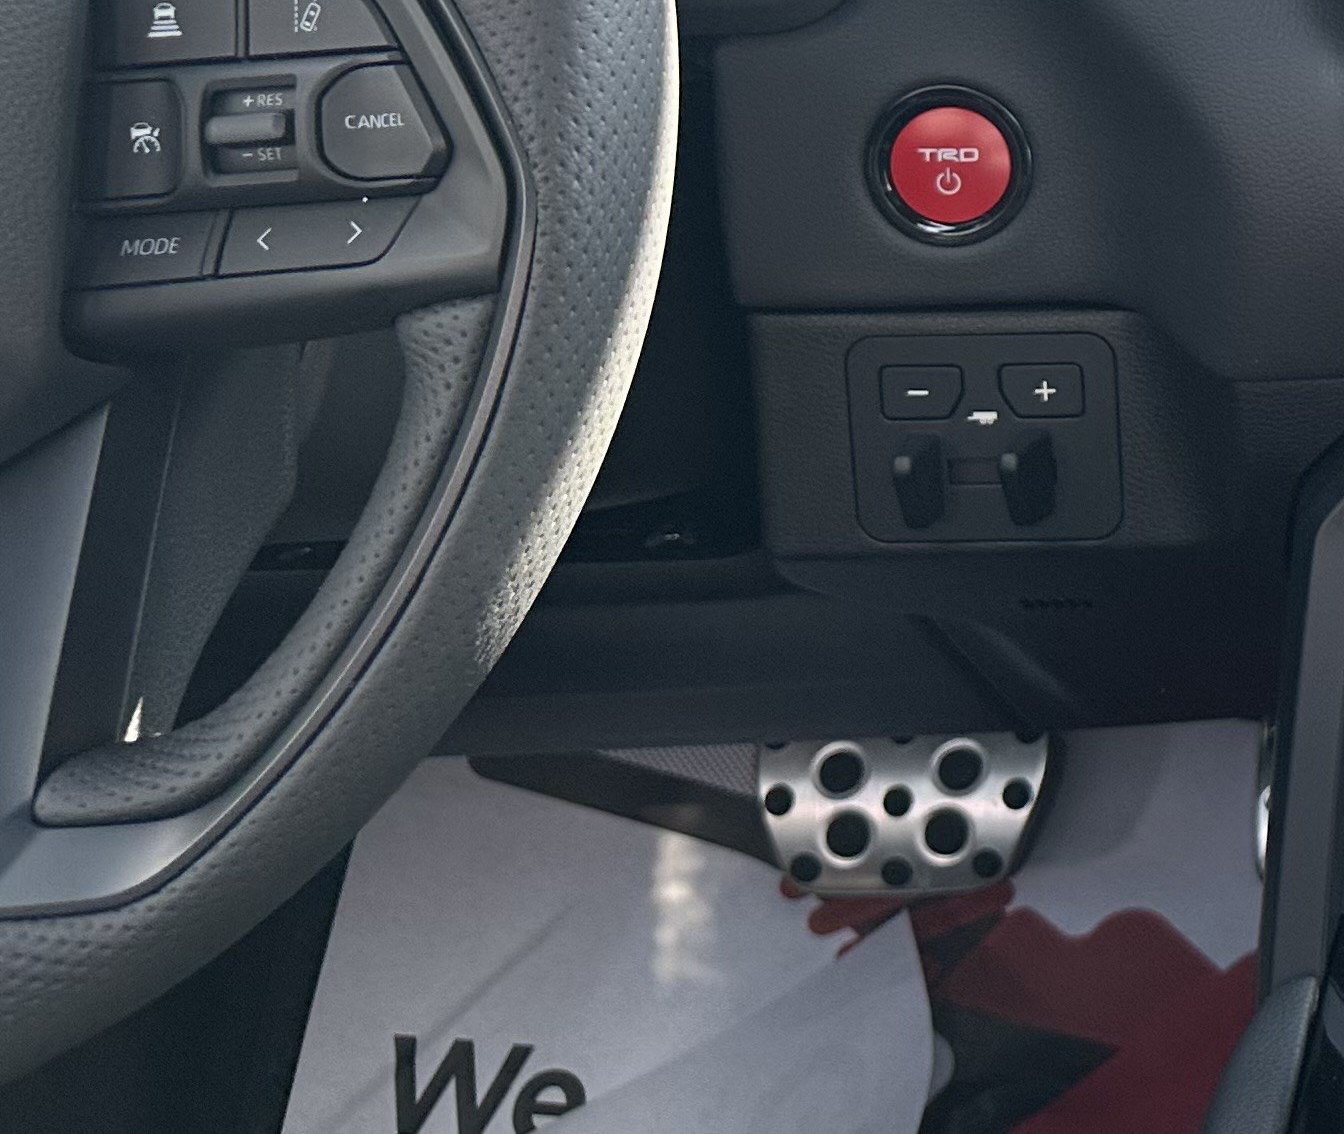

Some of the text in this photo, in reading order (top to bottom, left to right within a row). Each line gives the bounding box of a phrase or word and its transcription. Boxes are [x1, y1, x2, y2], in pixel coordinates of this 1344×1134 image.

[344, 112, 406, 130] CANCEL
[916, 146, 979, 163] TRD
[120, 236, 181, 257] MODE
[394, 1032, 587, 1134] We
